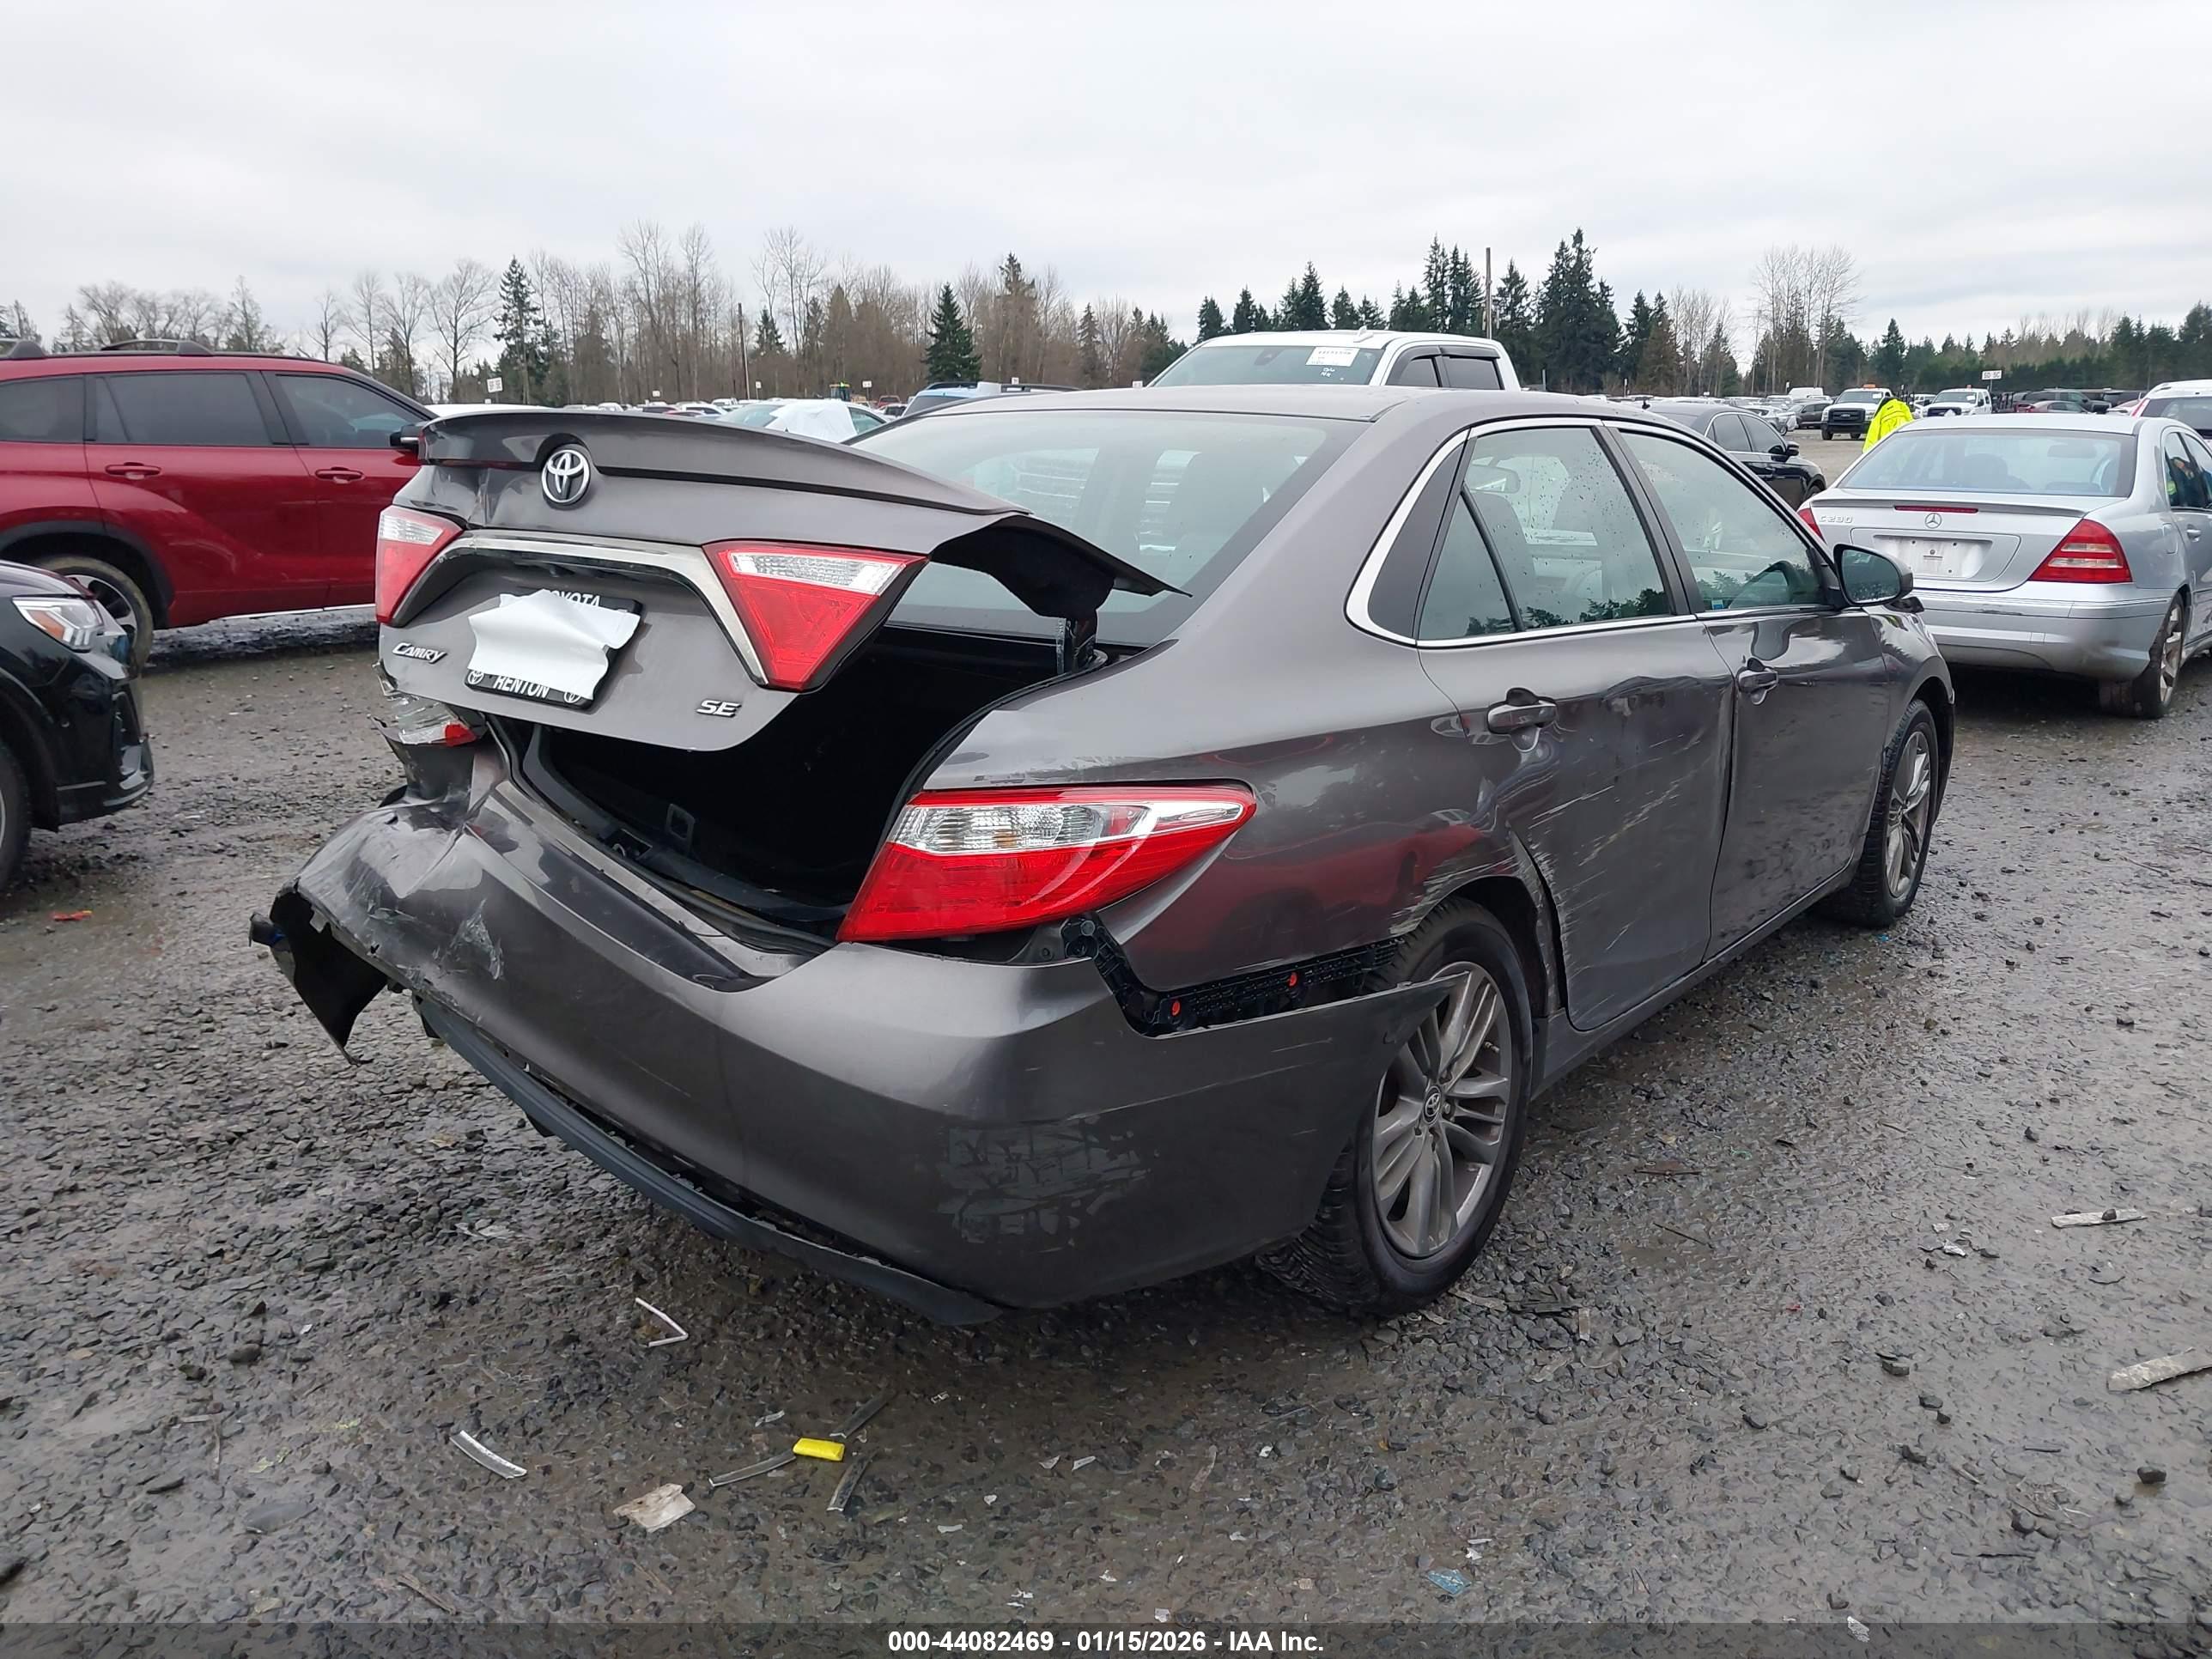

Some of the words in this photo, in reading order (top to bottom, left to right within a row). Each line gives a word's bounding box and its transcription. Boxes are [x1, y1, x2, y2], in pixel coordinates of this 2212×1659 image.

[550, 589, 601, 607] OYOTA
[492, 675, 550, 699] RENTON
[696, 699, 742, 717] SE
